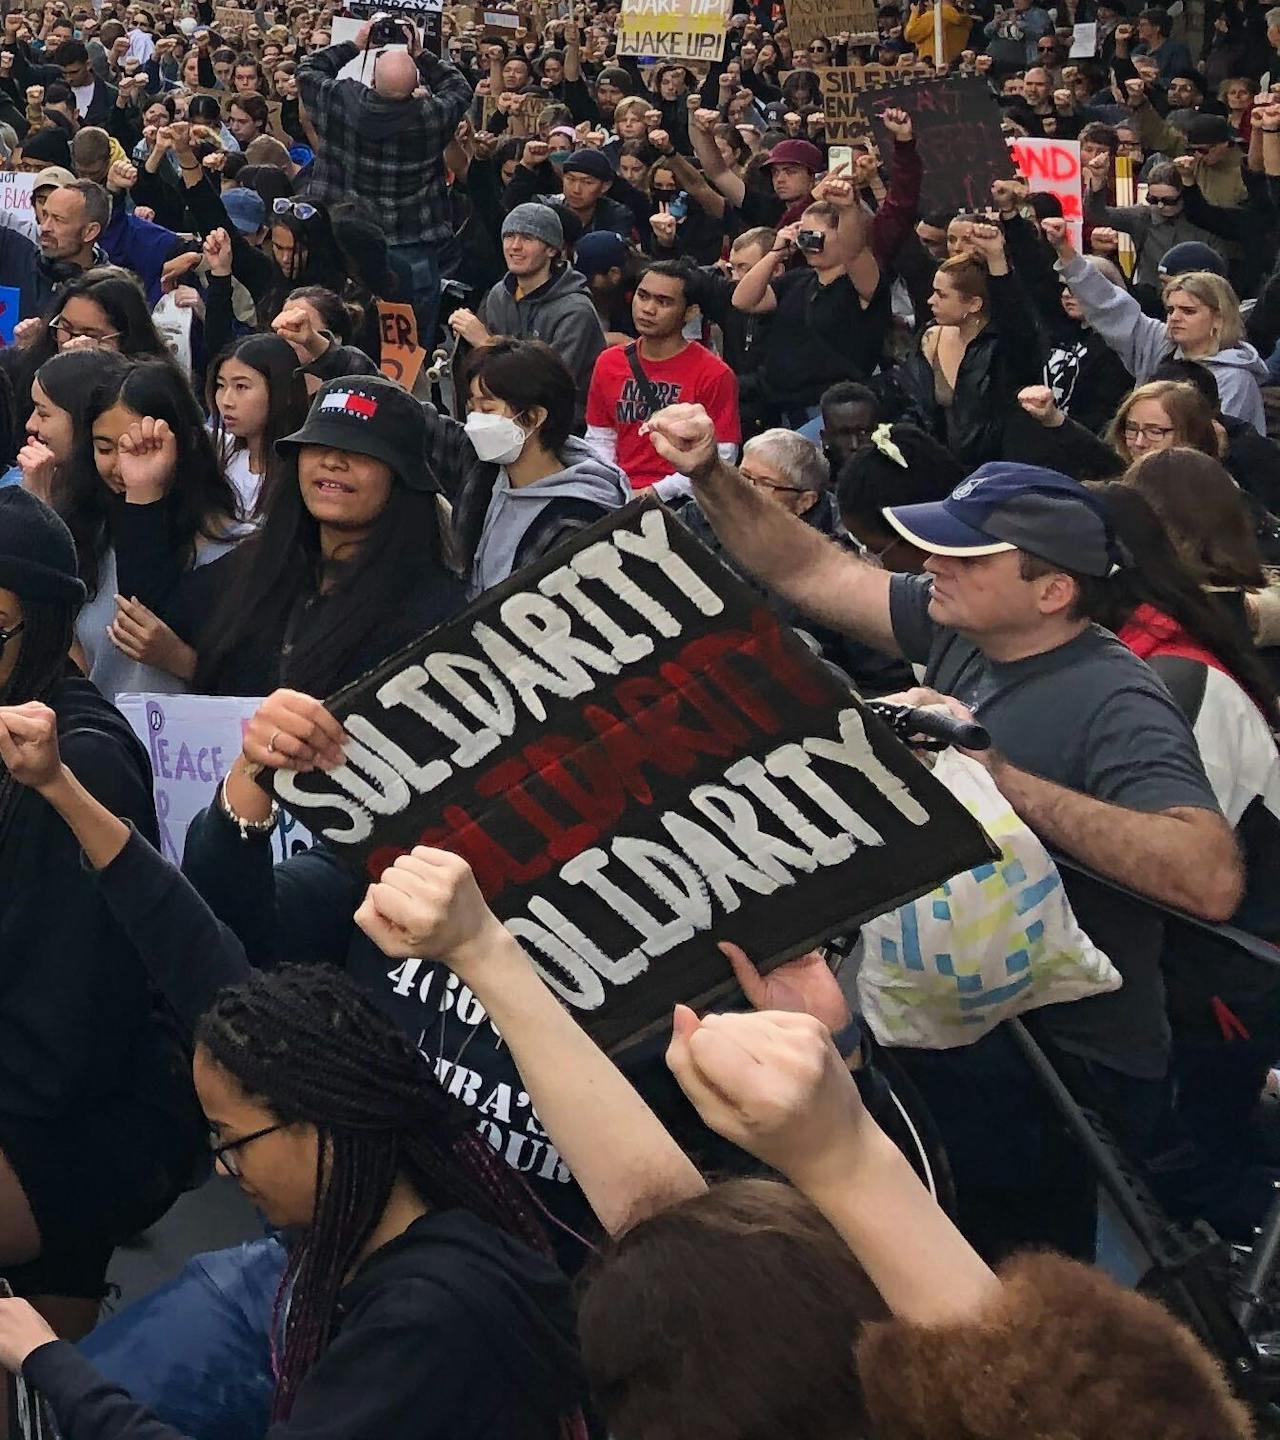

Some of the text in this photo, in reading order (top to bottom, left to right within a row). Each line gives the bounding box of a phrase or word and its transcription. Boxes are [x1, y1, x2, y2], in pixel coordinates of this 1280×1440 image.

[621, 31, 683, 55] WAKE
[4, 188, 33, 209] BLAC
[381, 313, 416, 353] ER
[318, 407, 369, 420] HILFIGER
[329, 388, 378, 401] TOMMY
[273, 508, 725, 844] SOLIDARITY
[145, 700, 223, 782] PEACE
[367, 607, 830, 903] LIDARITY
[503, 708, 931, 1010] OLIDARITY
